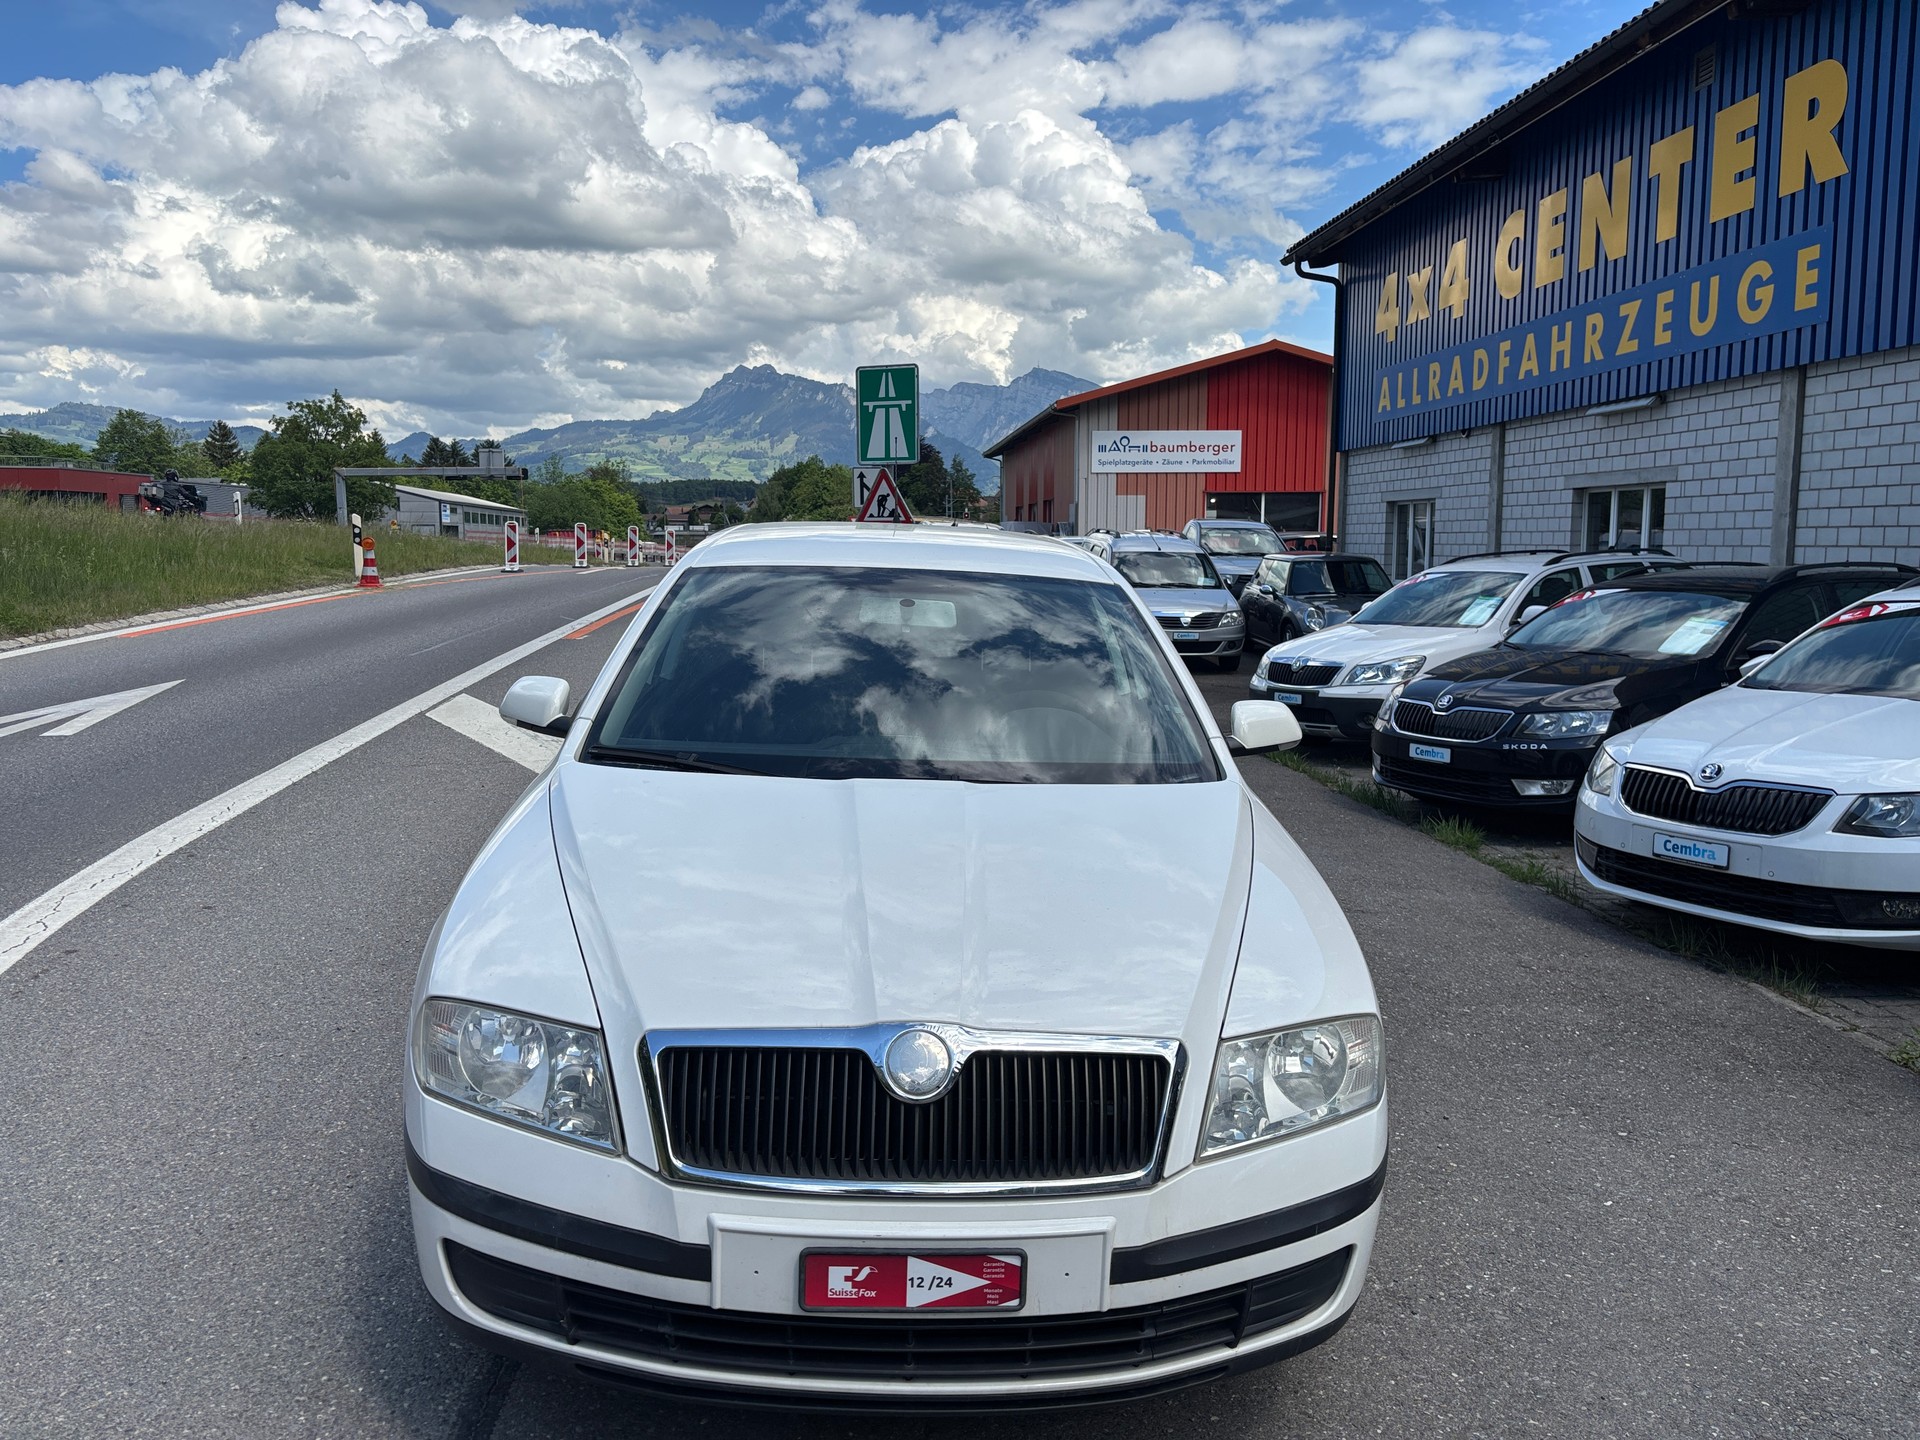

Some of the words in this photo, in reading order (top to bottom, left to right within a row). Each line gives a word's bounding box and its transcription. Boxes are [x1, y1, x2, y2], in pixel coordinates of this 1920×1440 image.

[1375, 238, 1469, 343] 4x4
[1494, 59, 1849, 300] CENTER
[1377, 243, 1822, 414] ALLRADFAHRZEUGE
[1150, 441, 1236, 456] baumberger
[1097, 458, 1153, 467] Spielplatzgeräte
[1161, 458, 1183, 466] Zäune
[1414, 746, 1445, 759] Cembra
[1663, 839, 1717, 861] Cembra
[908, 1277, 925, 1288] 12
[928, 1275, 953, 1290] /24
